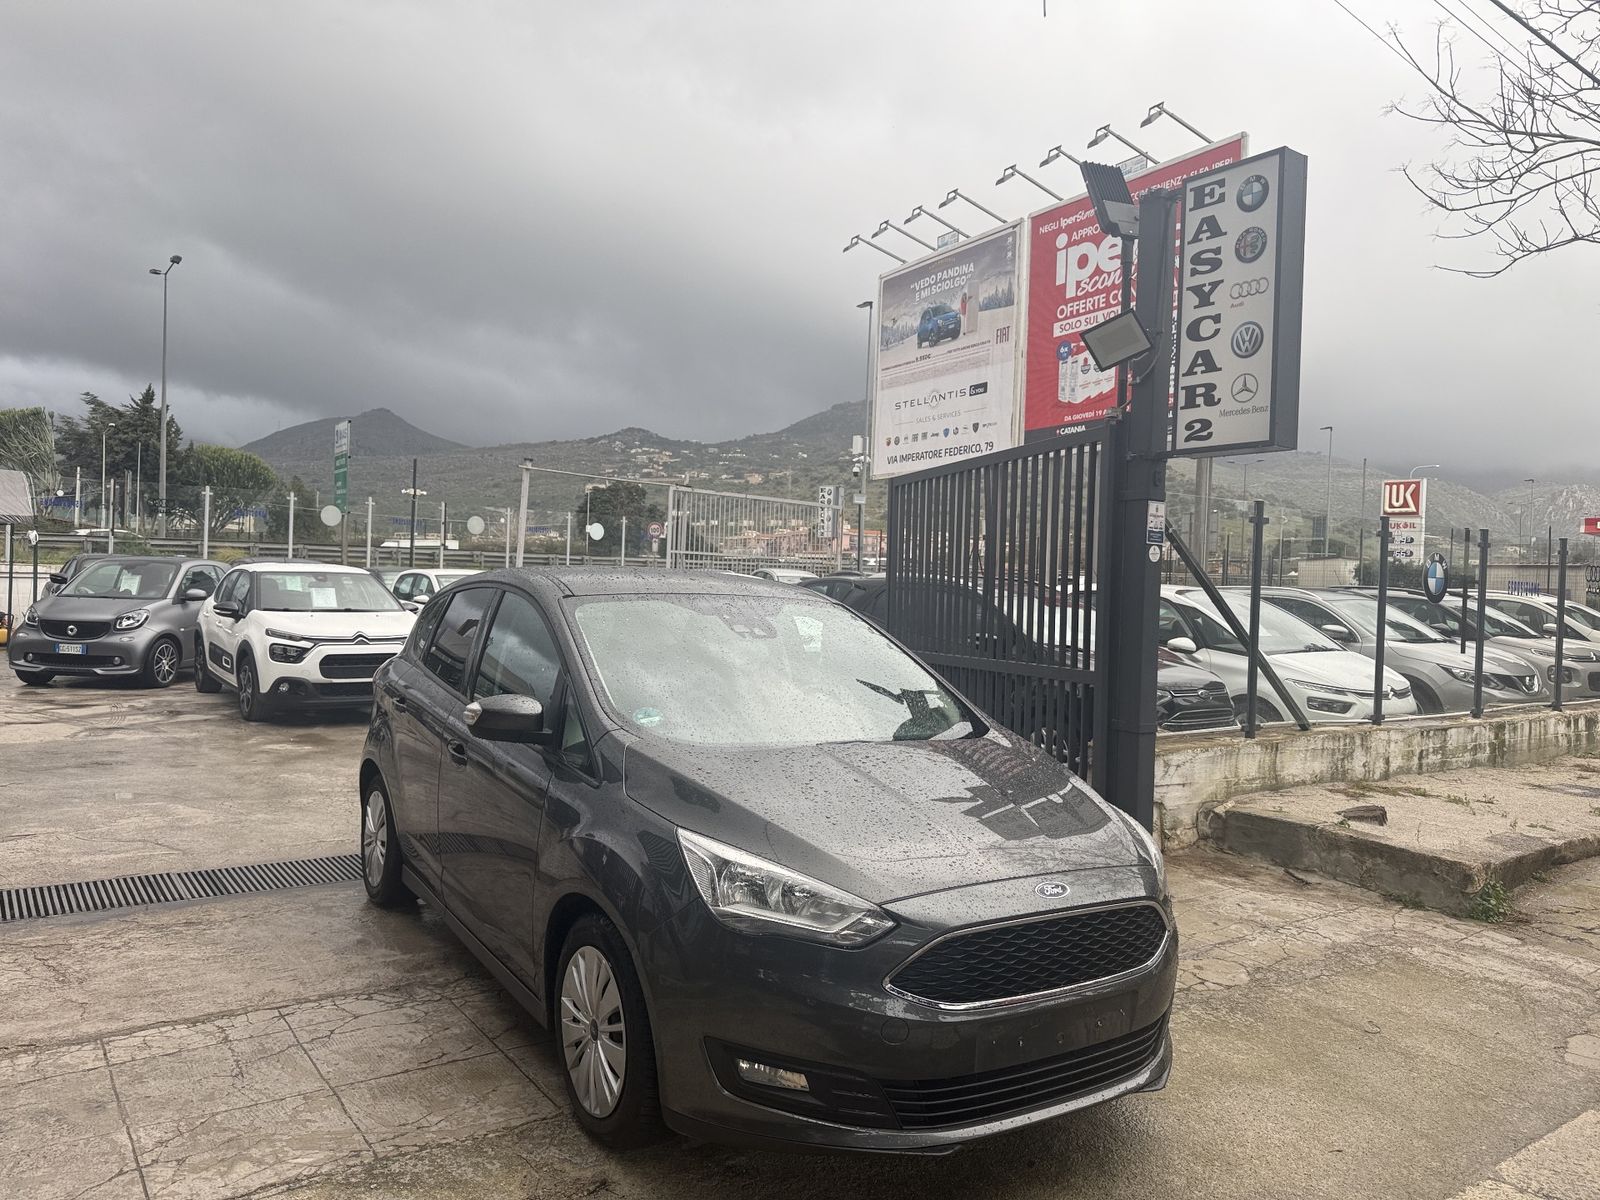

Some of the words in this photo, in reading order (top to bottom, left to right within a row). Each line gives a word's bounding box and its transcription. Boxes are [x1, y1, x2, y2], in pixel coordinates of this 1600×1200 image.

[1039, 220, 1059, 235] NEGLI
[1070, 223, 1101, 242] APPRO
[937, 262, 975, 282] PANDINA
[1055, 232, 1123, 299] ipe
[1077, 268, 1122, 297] scon
[1056, 295, 1106, 319] OFFERTE
[1230, 301, 1245, 309] Audi
[1059, 319, 1082, 333] SOLO
[1084, 313, 1099, 326] SUL
[995, 326, 1011, 344] FIAT
[894, 387, 967, 411] STELLANTIS
[916, 415, 931, 424] SALES
[937, 410, 961, 420] SERVICES
[1219, 406, 1251, 418] Mercedes
[1252, 405, 1269, 414] Benz
[1060, 425, 1086, 435] CATANIA
[886, 455, 898, 465] VIA
[899, 449, 943, 463] IMPERATORE
[944, 443, 983, 457] FEDERICO,
[984, 441, 994, 452] 79
[1389, 521, 1417, 530] UKOIL
